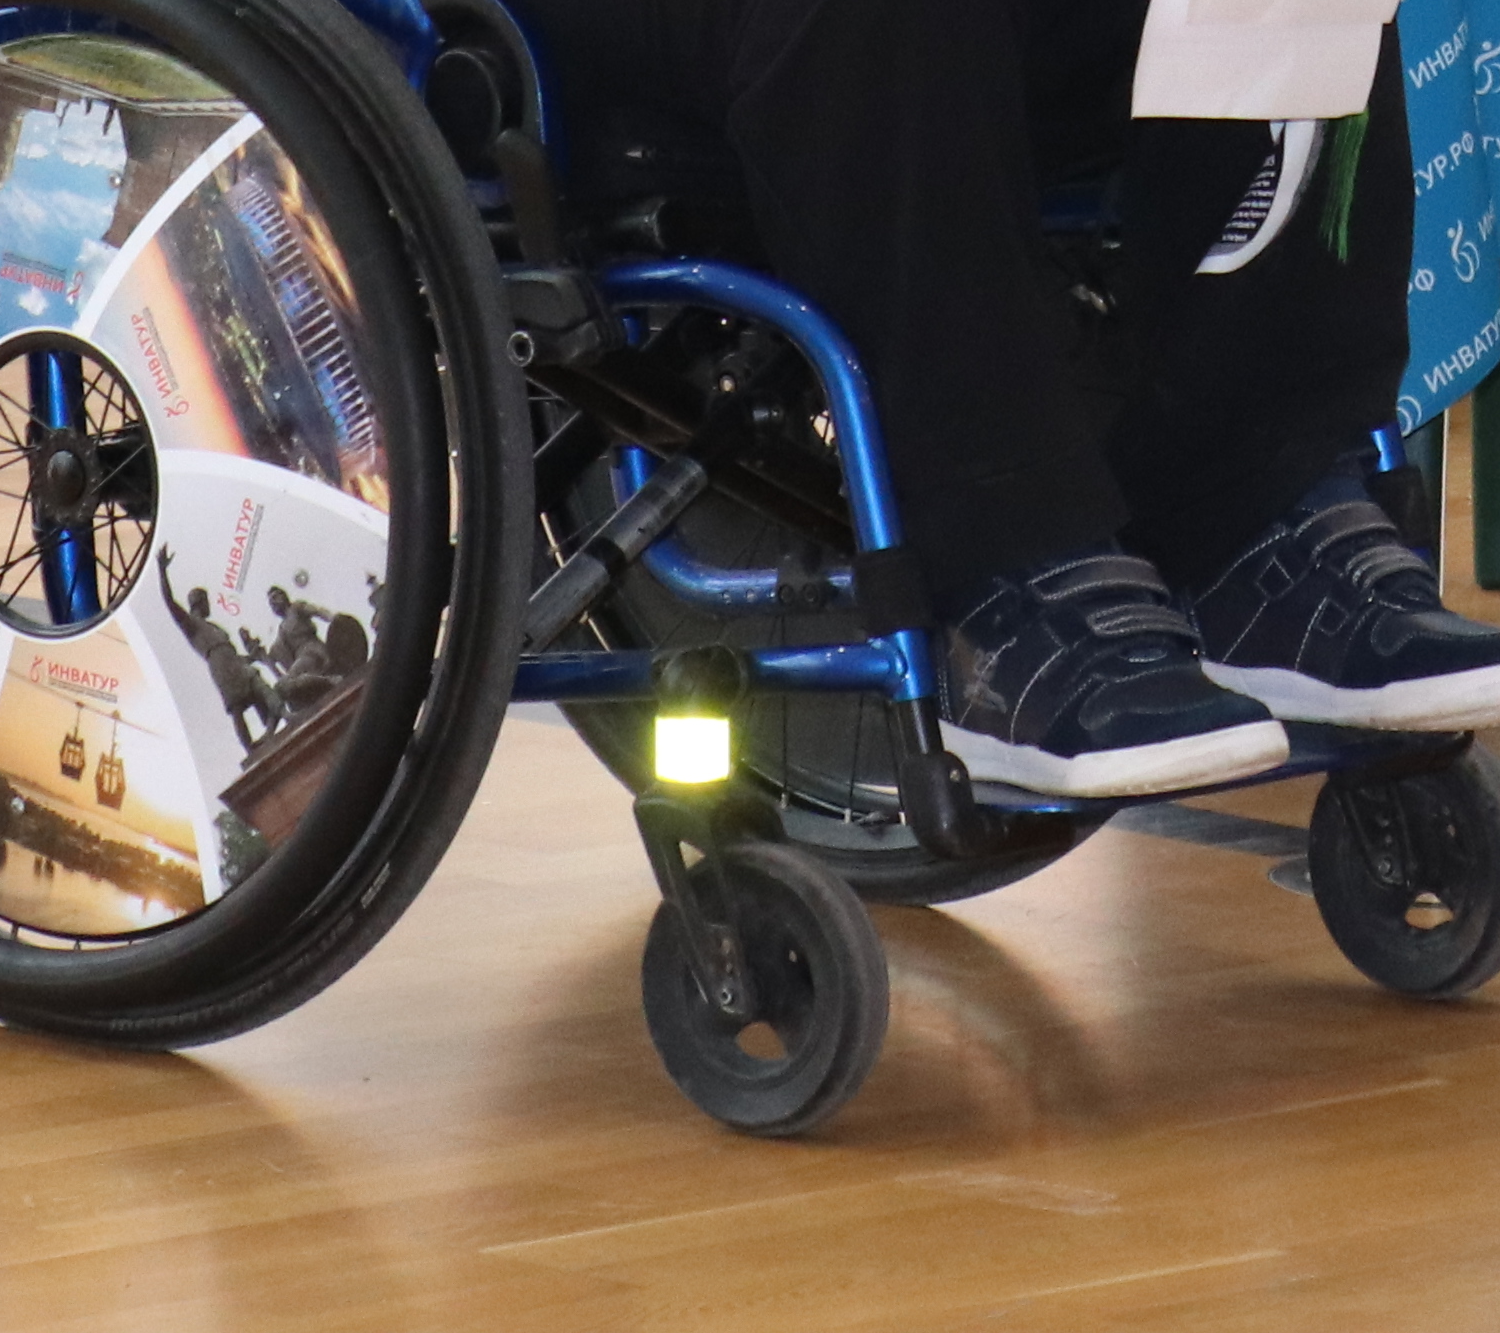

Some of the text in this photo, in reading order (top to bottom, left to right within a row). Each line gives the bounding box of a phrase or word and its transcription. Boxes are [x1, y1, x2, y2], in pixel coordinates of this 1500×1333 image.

[131, 312, 174, 401] ИНВАТУР
[222, 497, 255, 591] ИНВАТУР
[47, 662, 120, 693] ИНВАТУР
